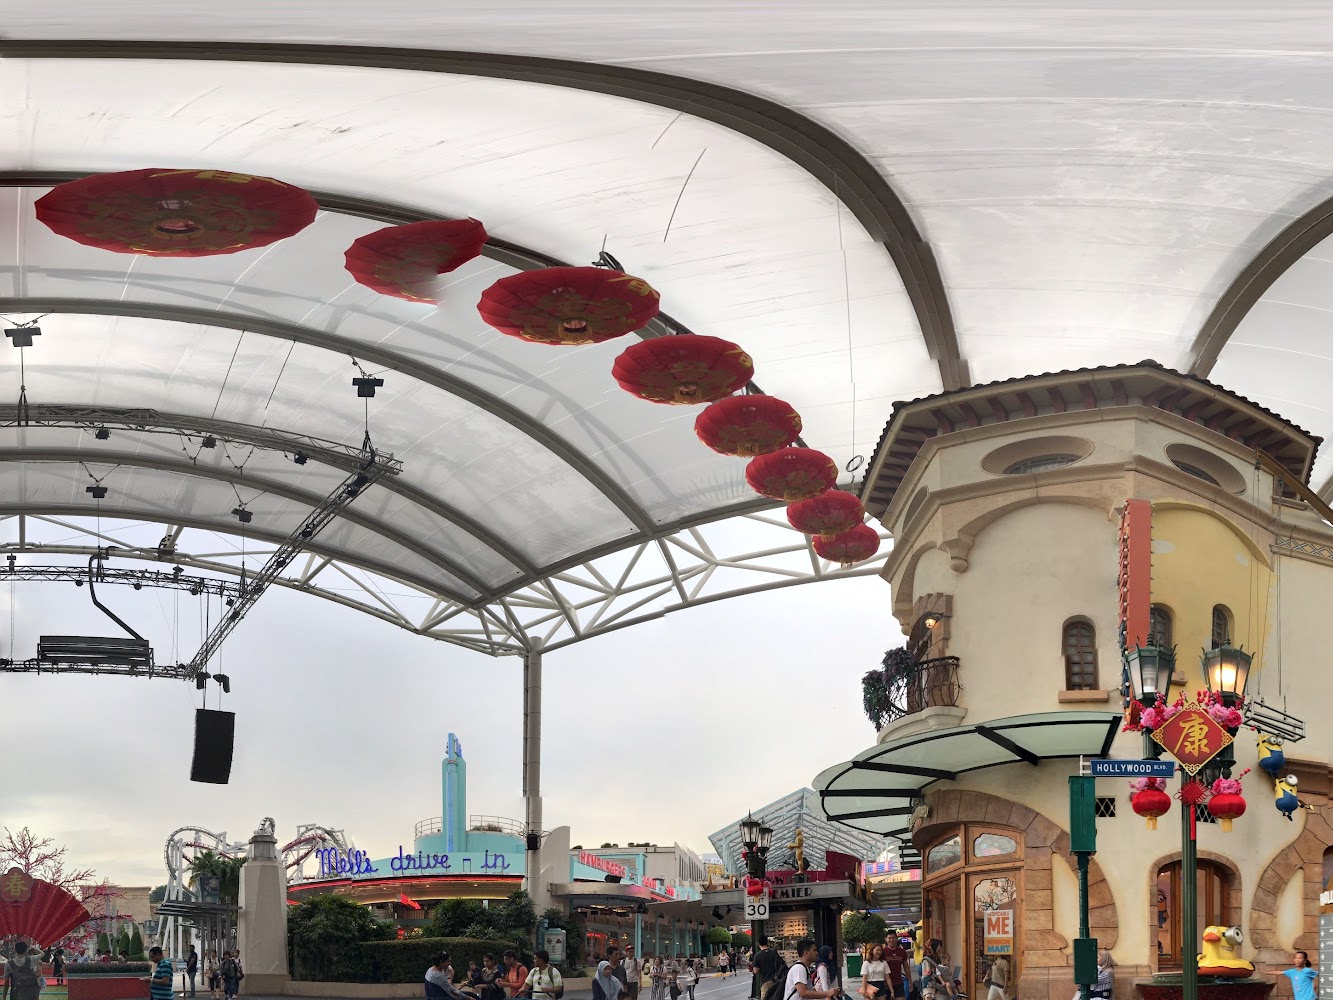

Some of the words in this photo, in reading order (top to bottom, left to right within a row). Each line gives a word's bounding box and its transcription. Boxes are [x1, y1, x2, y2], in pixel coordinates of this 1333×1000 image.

[1173, 713, 1211, 758] 康
[1096, 763, 1152, 773] HOLLYWOOD
[391, 845, 452, 871] drive
[481, 850, 511, 870] in
[579, 850, 627, 878] HAMBURGERS
[3, 872, 28, 897] 春
[747, 904, 767, 916] 30
[987, 916, 1010, 935] ME
[987, 938, 1010, 946] MINION
[987, 945, 1010, 953] MART
